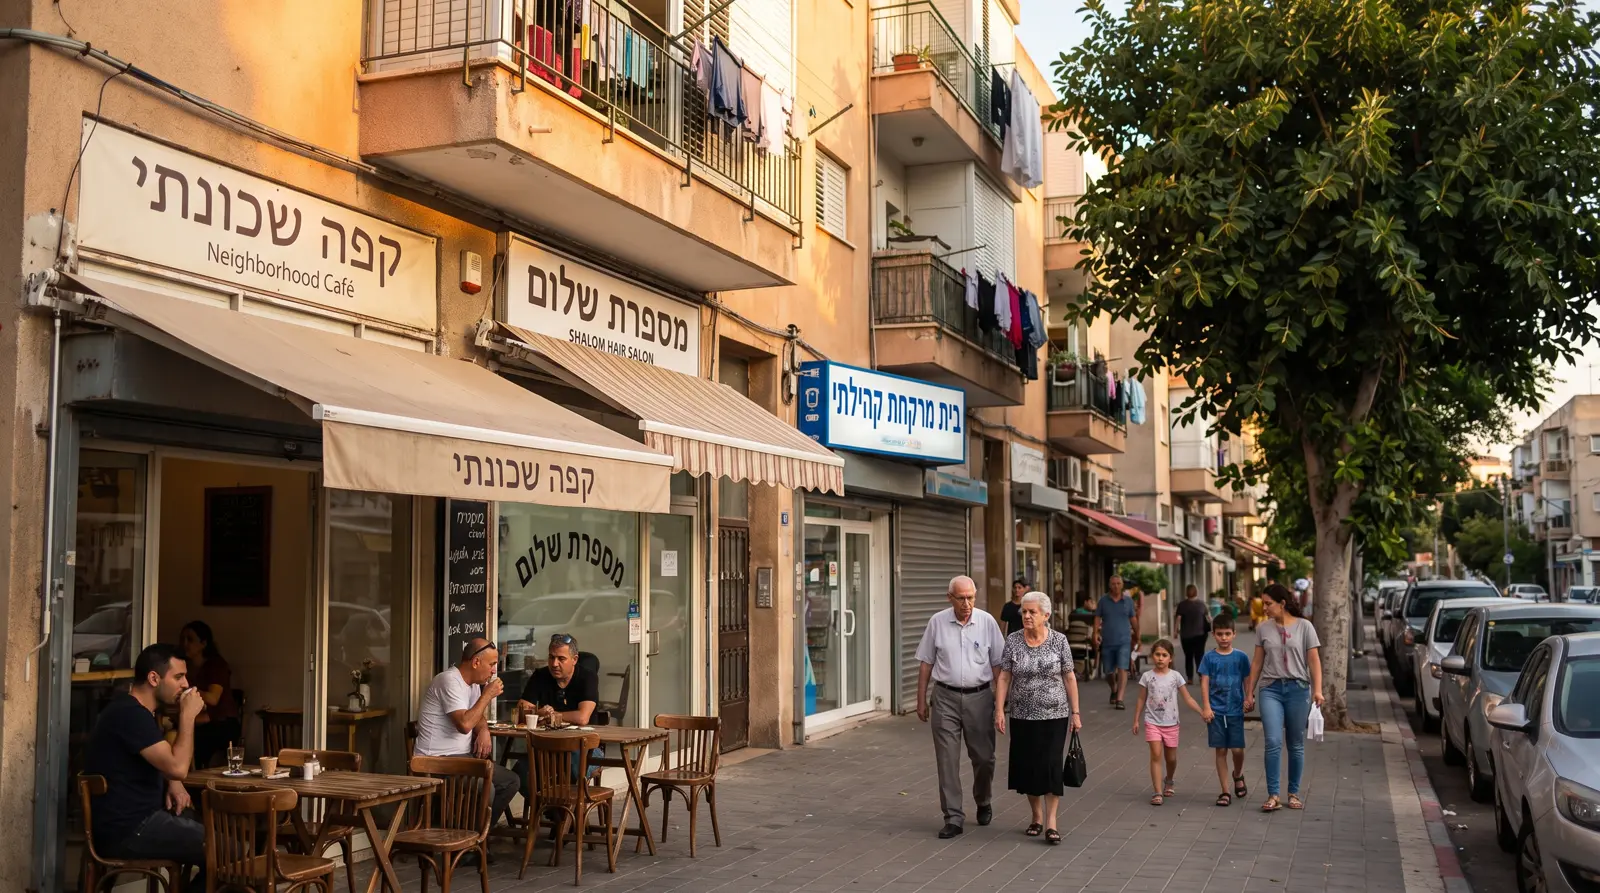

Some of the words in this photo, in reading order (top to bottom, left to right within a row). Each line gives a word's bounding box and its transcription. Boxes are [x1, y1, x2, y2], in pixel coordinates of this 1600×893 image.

[132, 156, 302, 247] שכונתי
[208, 241, 320, 289] Neighborhood
[324, 273, 355, 298] Café
[322, 217, 402, 288] קפה
[528, 264, 598, 322] שלום
[569, 328, 606, 351] SHALOM
[607, 340, 627, 358] HAIR
[628, 346, 654, 365] SALON
[608, 294, 688, 352] מספרת
[832, 376, 883, 430] קהילתי
[887, 393, 935, 434] מרקחת
[938, 402, 961, 433] בית
[453, 452, 540, 491] שכונתי
[550, 465, 595, 504] קפה
[515, 532, 562, 588] שלום
[568, 531, 625, 588] מספרת
